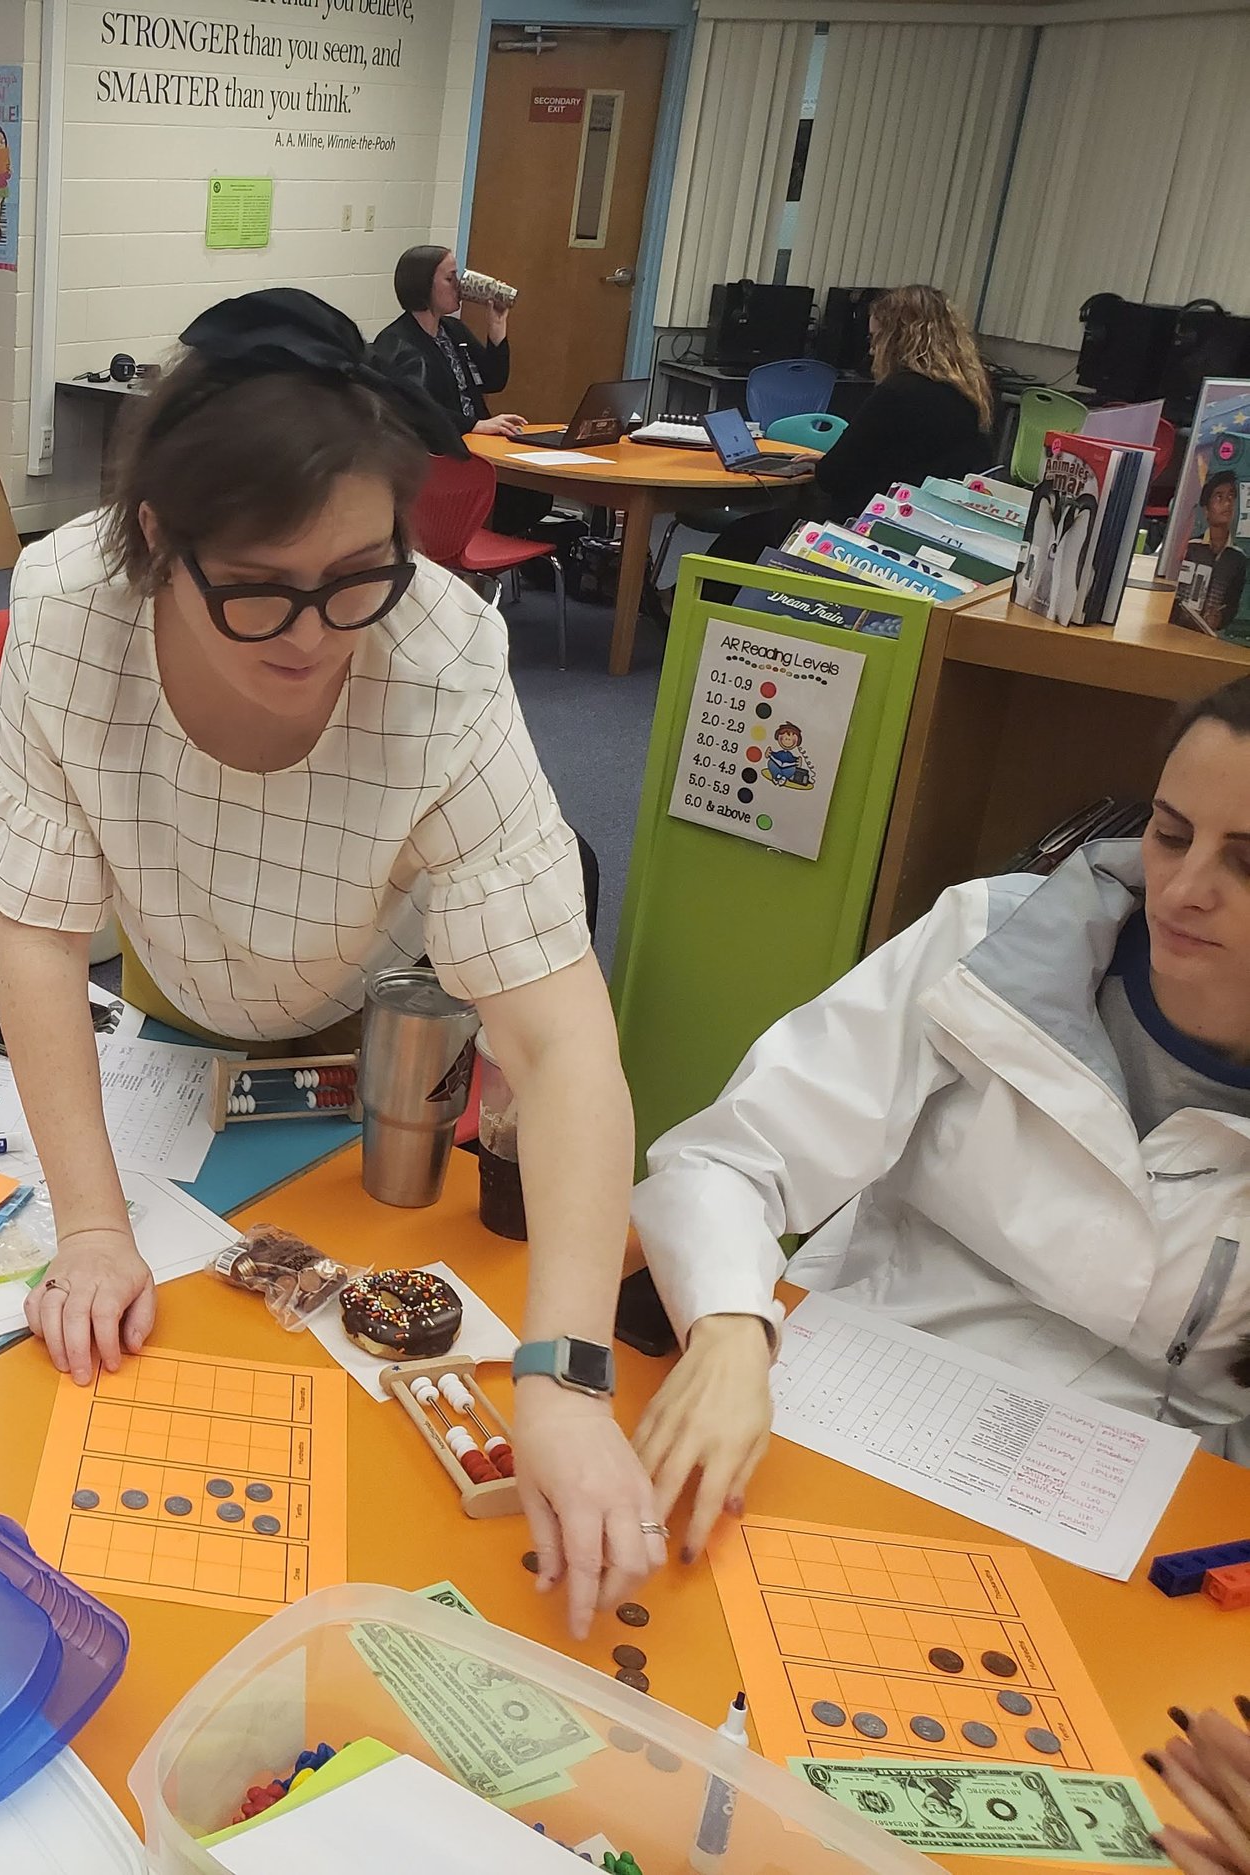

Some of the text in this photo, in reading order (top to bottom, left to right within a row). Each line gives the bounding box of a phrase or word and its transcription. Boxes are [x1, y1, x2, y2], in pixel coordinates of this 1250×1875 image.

[101, 11, 401, 70] STRONGER than you seem, and
[96, 70, 220, 108] SMARTER
[225, 76, 264, 109] than
[267, 90, 300, 120] you
[533, 97, 581, 106] SECONDARY
[547, 105, 566, 113] EXIT
[275, 132, 396, 152] A. A. Milne, Winnie-the-Pooh
[1046, 458, 1090, 480] Animales
[1052, 474, 1084, 496] mar
[833, 546, 937, 599] SNOWMEN
[767, 591, 845, 625] Dream Train
[721, 635, 839, 676] AR Reading Levels
[684, 794, 751, 823] 6.0 & above
